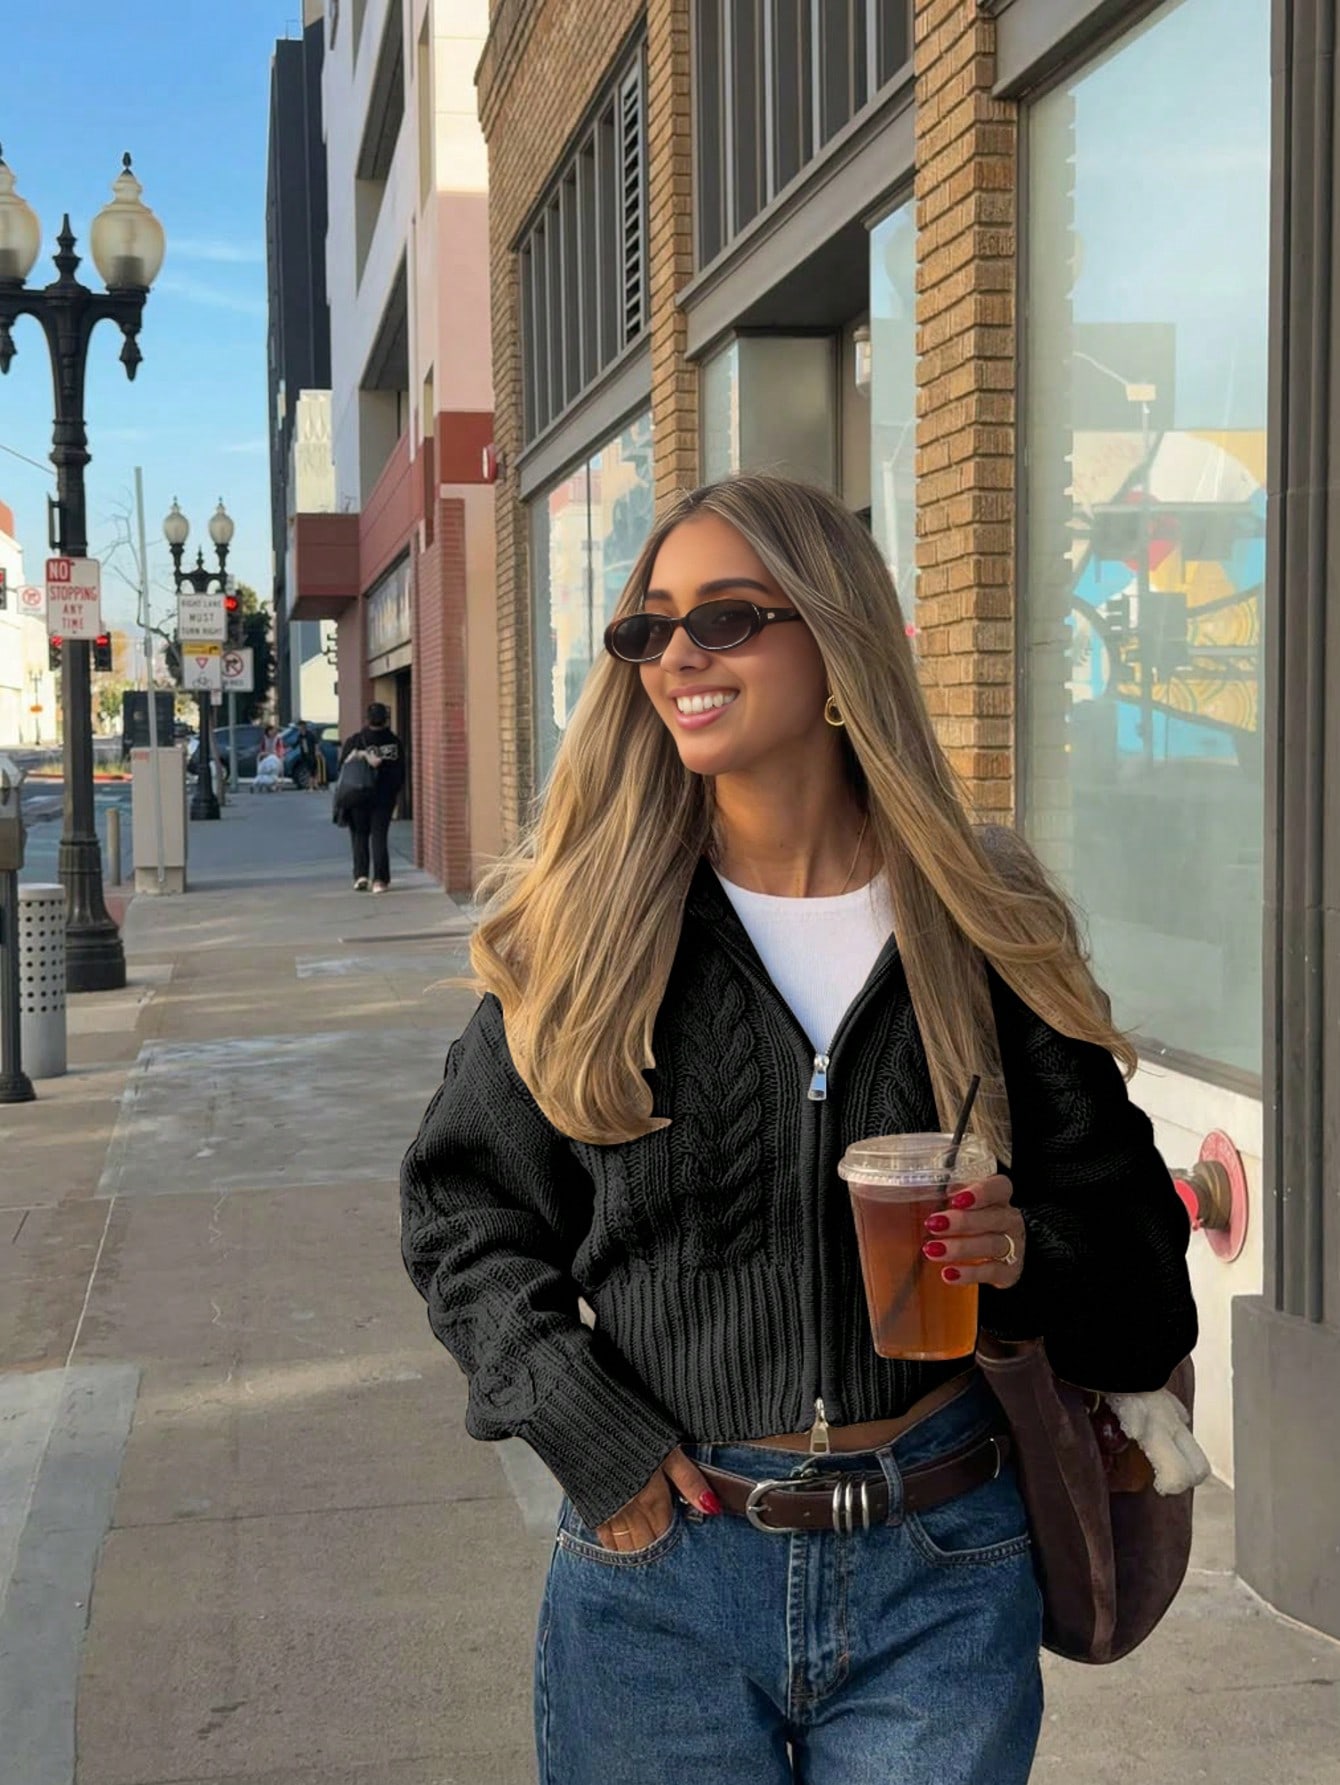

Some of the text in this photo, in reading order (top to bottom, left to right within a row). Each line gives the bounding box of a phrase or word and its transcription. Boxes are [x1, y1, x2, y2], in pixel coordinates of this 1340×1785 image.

[48, 561, 69, 580] NO
[50, 586, 97, 601] STOPPING
[63, 604, 83, 614] ANY
[189, 613, 214, 622] MUST
[62, 618, 84, 630] TIME
